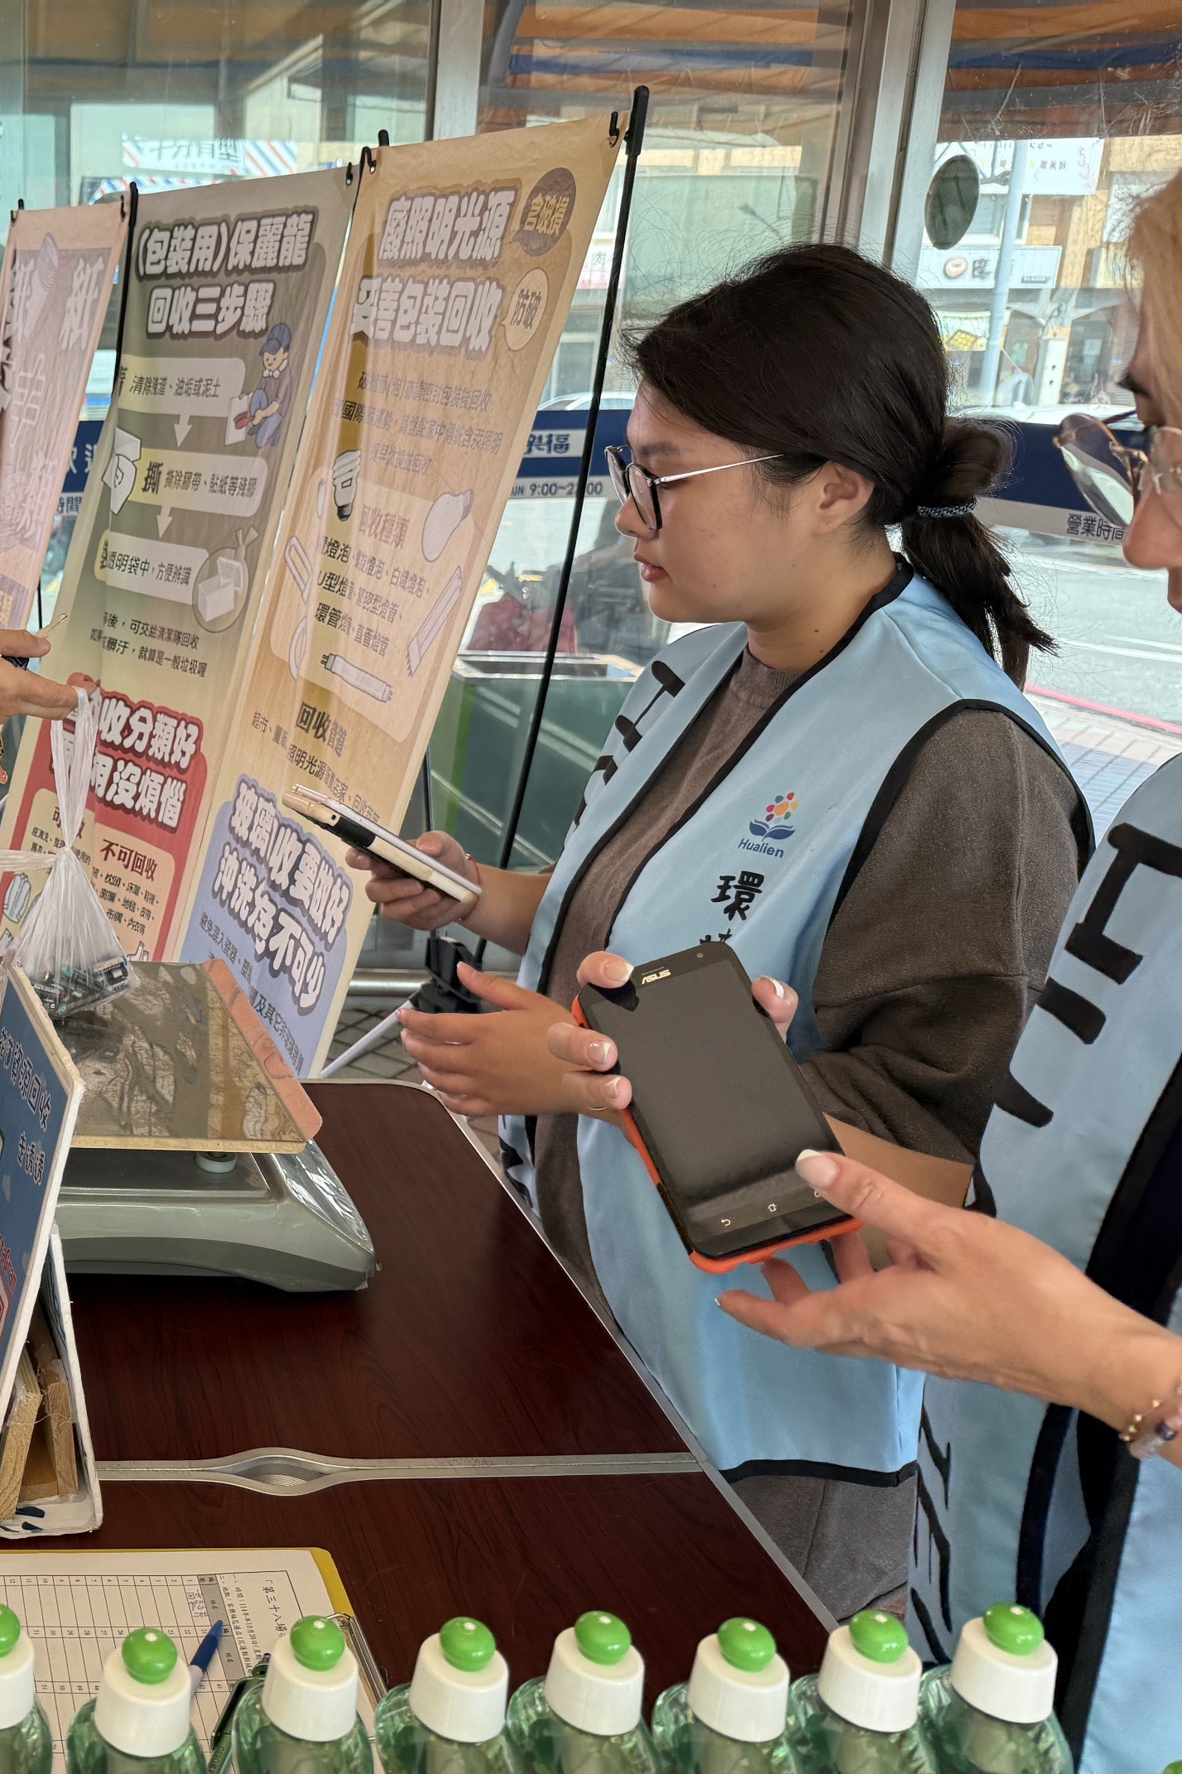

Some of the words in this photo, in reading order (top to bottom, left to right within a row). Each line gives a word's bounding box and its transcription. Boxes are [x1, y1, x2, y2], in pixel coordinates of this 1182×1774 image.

[146, 281, 276, 336] 回收三步驟
[97, 697, 200, 770] 收分類好
[90, 751, 187, 829] 用沒煩惱
[100, 838, 158, 882] 不可回收
[738, 837, 784, 859] Hualien
[642, 969, 672, 985] ASUS
